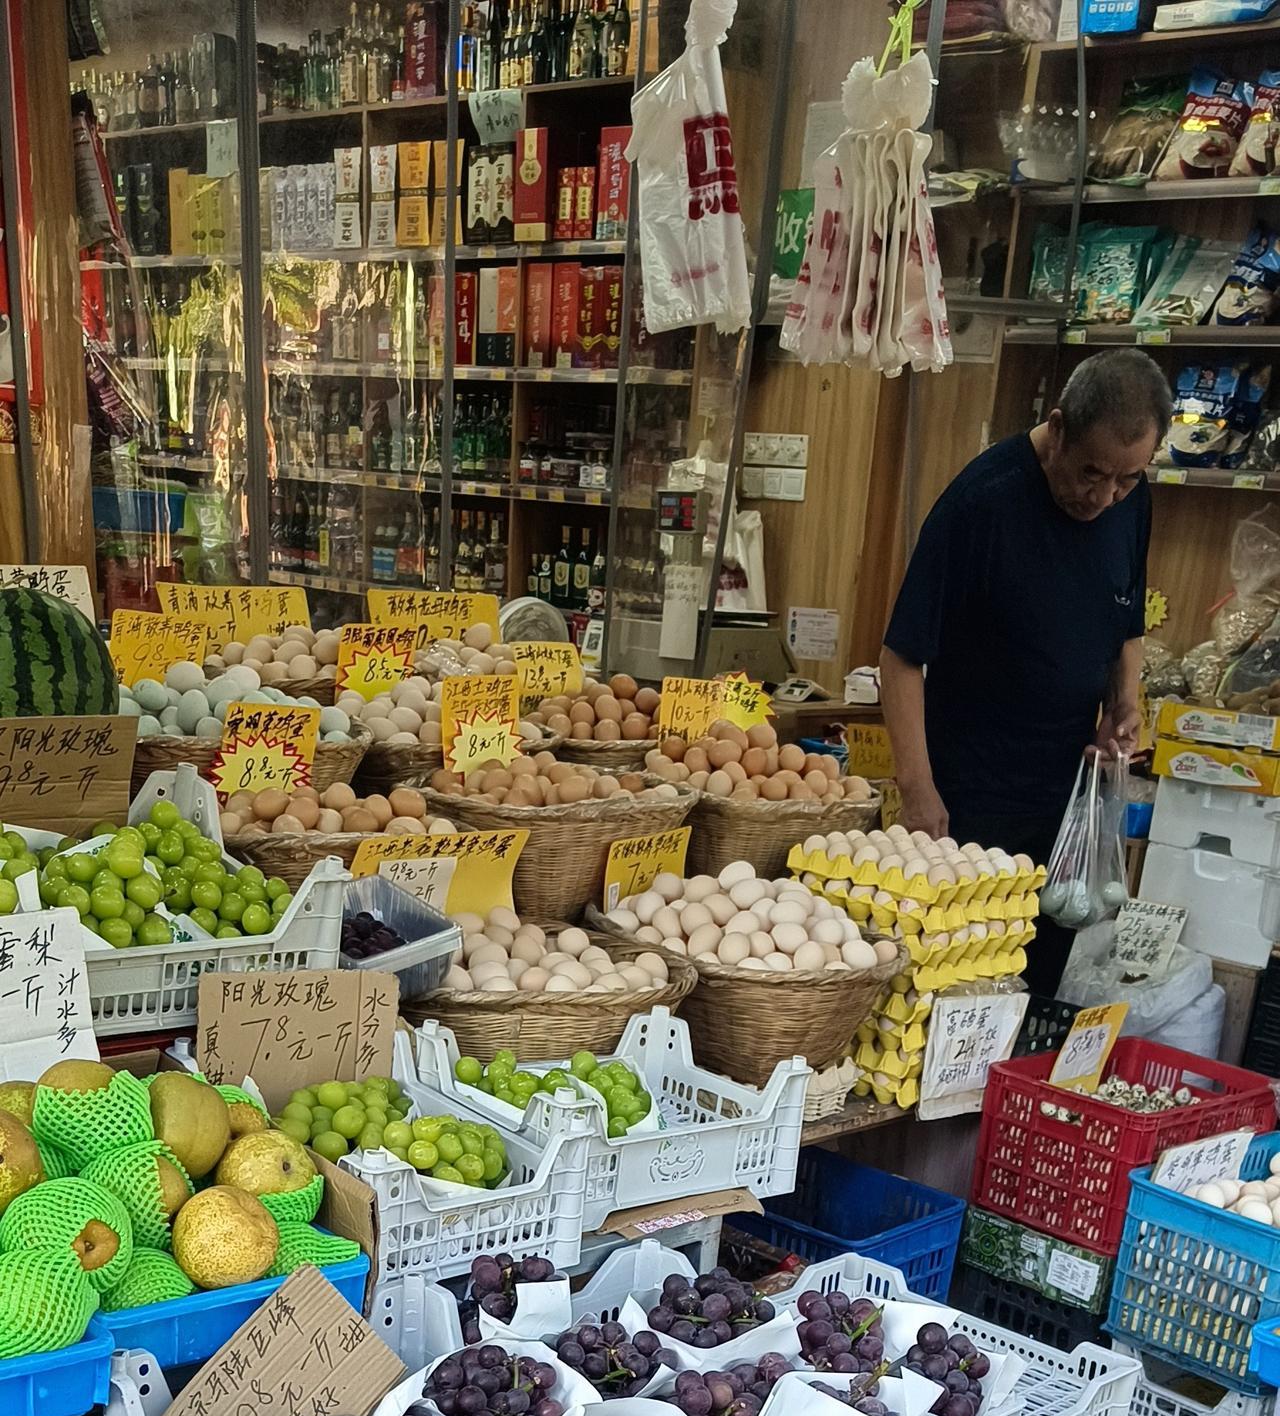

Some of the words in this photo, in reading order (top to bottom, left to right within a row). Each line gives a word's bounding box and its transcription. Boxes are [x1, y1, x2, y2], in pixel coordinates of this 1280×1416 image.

[468, 731, 507, 758] 8元一斤
[239, 755, 294, 790] 8.8元一斤
[388, 861, 439, 882] 9.8元一斤
[415, 883, 436, 903] 2斤
[57, 968, 81, 1054] 汁水多
[221, 975, 338, 1014] 阳光玫瑰
[240, 1014, 353, 1081] 7.8元一斤
[355, 987, 391, 1075] 水分多
